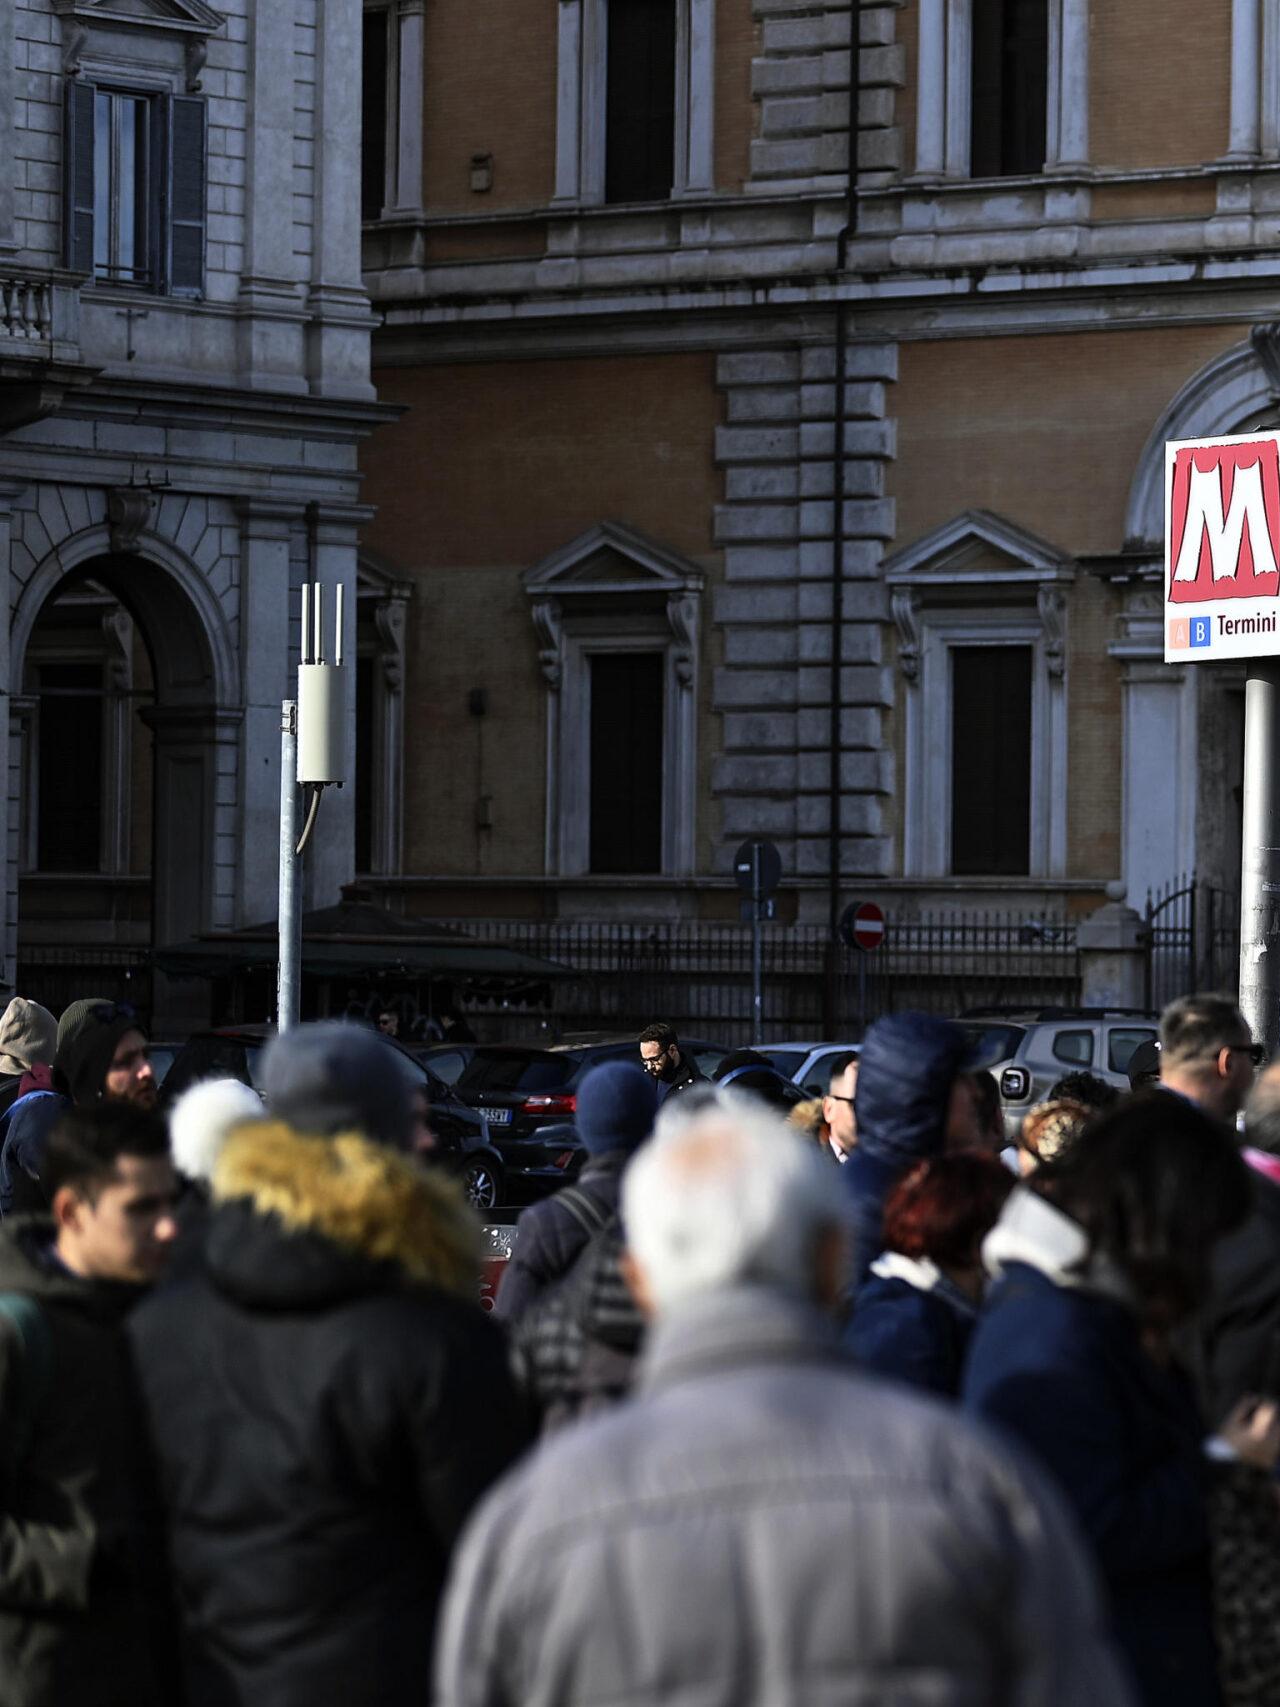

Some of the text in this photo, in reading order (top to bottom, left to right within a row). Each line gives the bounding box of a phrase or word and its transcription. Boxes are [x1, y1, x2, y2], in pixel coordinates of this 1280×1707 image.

[1173, 455, 1280, 584] M
[1196, 621, 1206, 642] B
[1217, 611, 1277, 636] Termini
